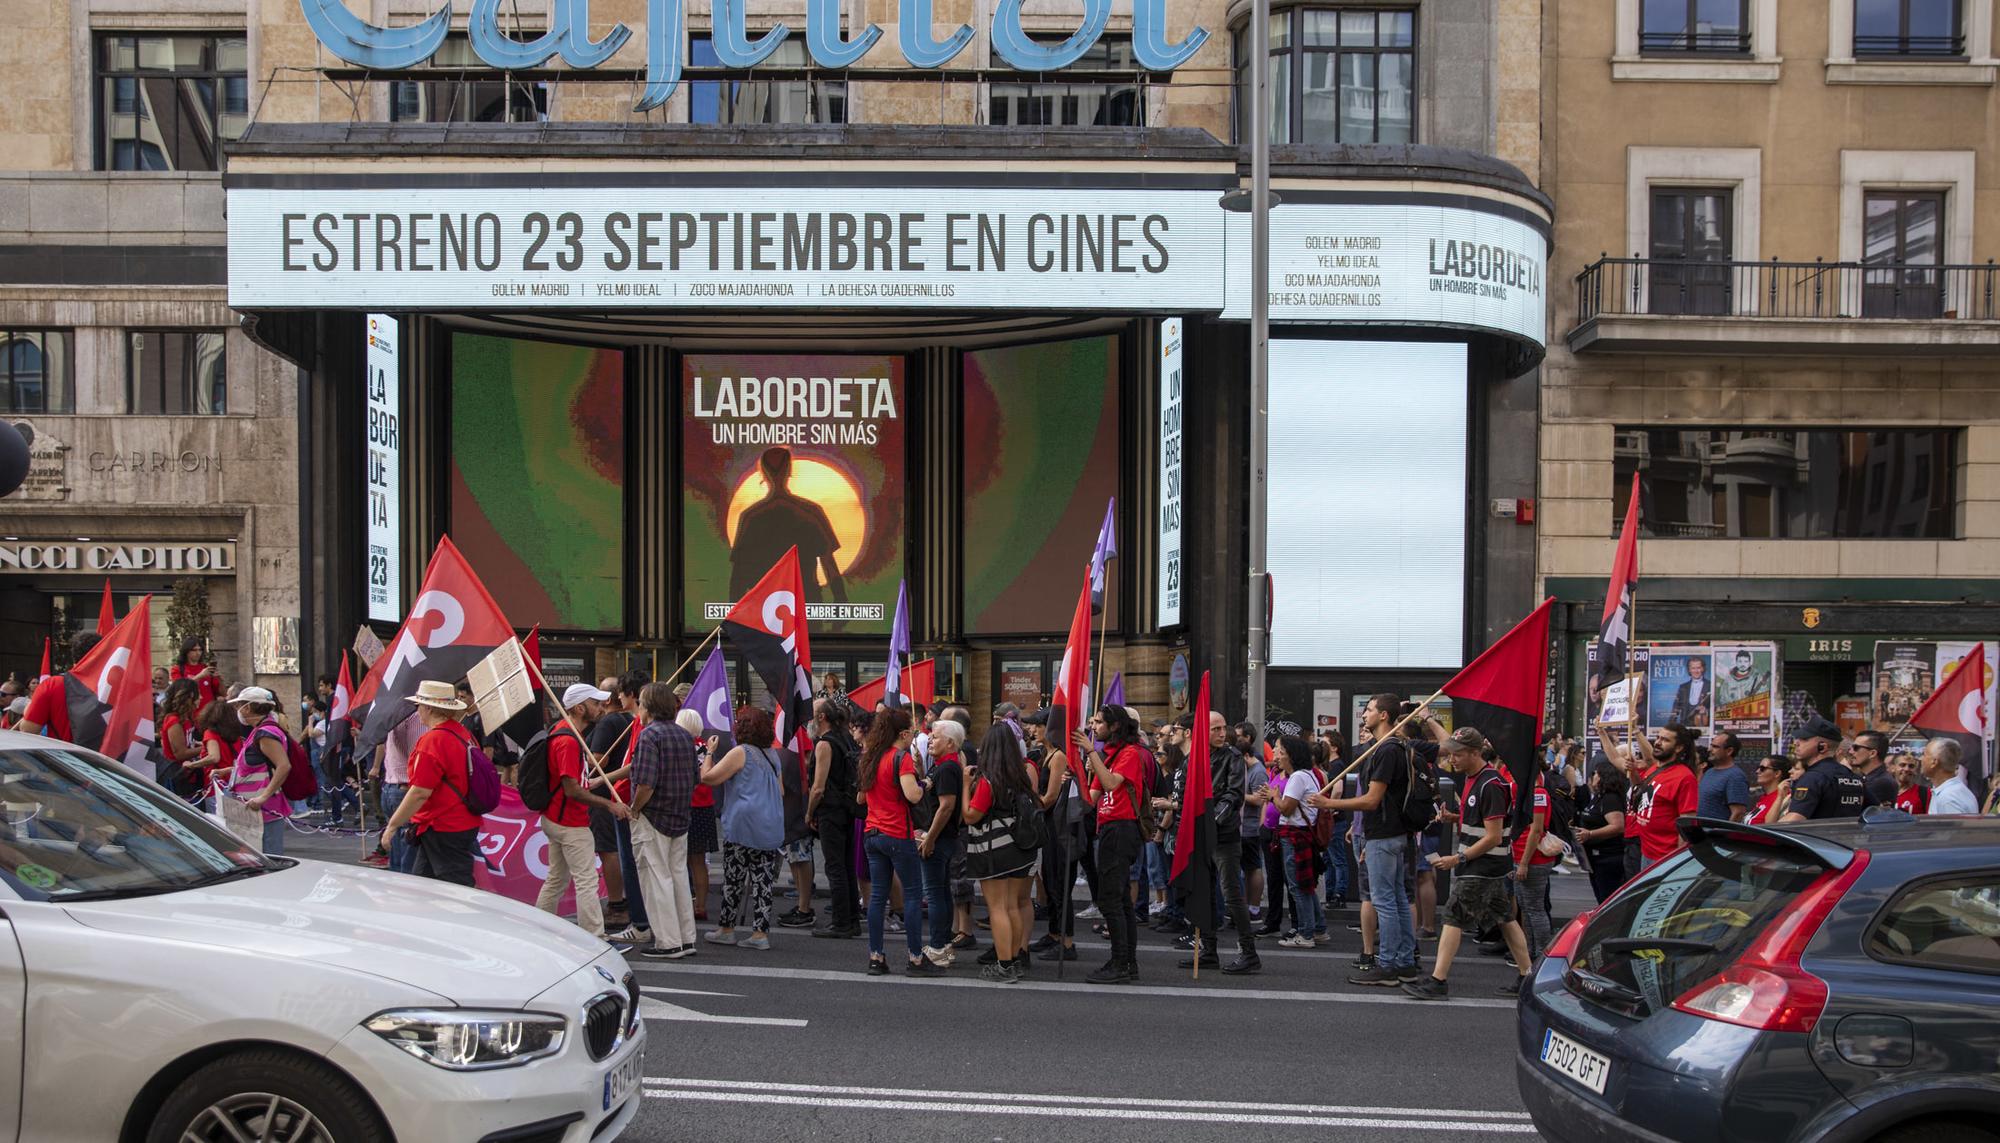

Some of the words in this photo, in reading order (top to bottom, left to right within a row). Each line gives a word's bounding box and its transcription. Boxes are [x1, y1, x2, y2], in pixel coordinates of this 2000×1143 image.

[282, 212, 501, 272] ESTRENO
[522, 212, 584, 272] 23
[604, 212, 925, 272] SEPTIEMBRE
[946, 213, 1006, 273] EN
[1027, 213, 1170, 274] CINES
[1305, 236, 1338, 249] GOLEM
[1344, 236, 1381, 250] MADRID
[1317, 255, 1351, 268] YELMO
[1353, 255, 1381, 268] IDEAL
[1429, 237, 1540, 299] LABORDETA
[491, 283, 526, 297] GOLEM
[531, 283, 569, 297] MADRID
[596, 283, 631, 297] YELMO
[634, 283, 661, 297] IDEAL
[689, 283, 716, 297] ZOCO
[718, 283, 794, 297] MAJADAHONDA
[821, 283, 836, 298] LA
[837, 283, 879, 298] DEHESA
[881, 283, 955, 298] CUADERNILLOS
[1306, 274, 1381, 288] MAJADAHONDA
[1429, 278, 1442, 292] UN
[1444, 280, 1478, 296] HOMBRE
[1478, 283, 1492, 297] SIN
[1309, 292, 1381, 306] CUADERNILLOS
[369, 364, 386, 405] LA
[1169, 368, 1180, 401] UN
[693, 376, 897, 419] LABORDETA
[369, 406, 398, 450] BOR
[712, 423, 735, 444] UN
[738, 423, 807, 445] HOMBRE
[810, 423, 838, 445] SIN
[840, 420, 877, 445] MÁS
[369, 448, 388, 488] DE
[1167, 469, 1180, 500] SIN
[370, 490, 388, 529] TA
[87, 546, 233, 571] CAPITOL
[371, 555, 388, 587] 23
[1167, 559, 1179, 591] 23
[838, 605, 851, 618] EN
[853, 605, 880, 619] CINES
[1809, 639, 1852, 652] IRIS
[1654, 666, 1686, 678] RIEU
[1547, 1036, 1578, 1073] 7502
[1579, 1052, 1606, 1087] GFT
